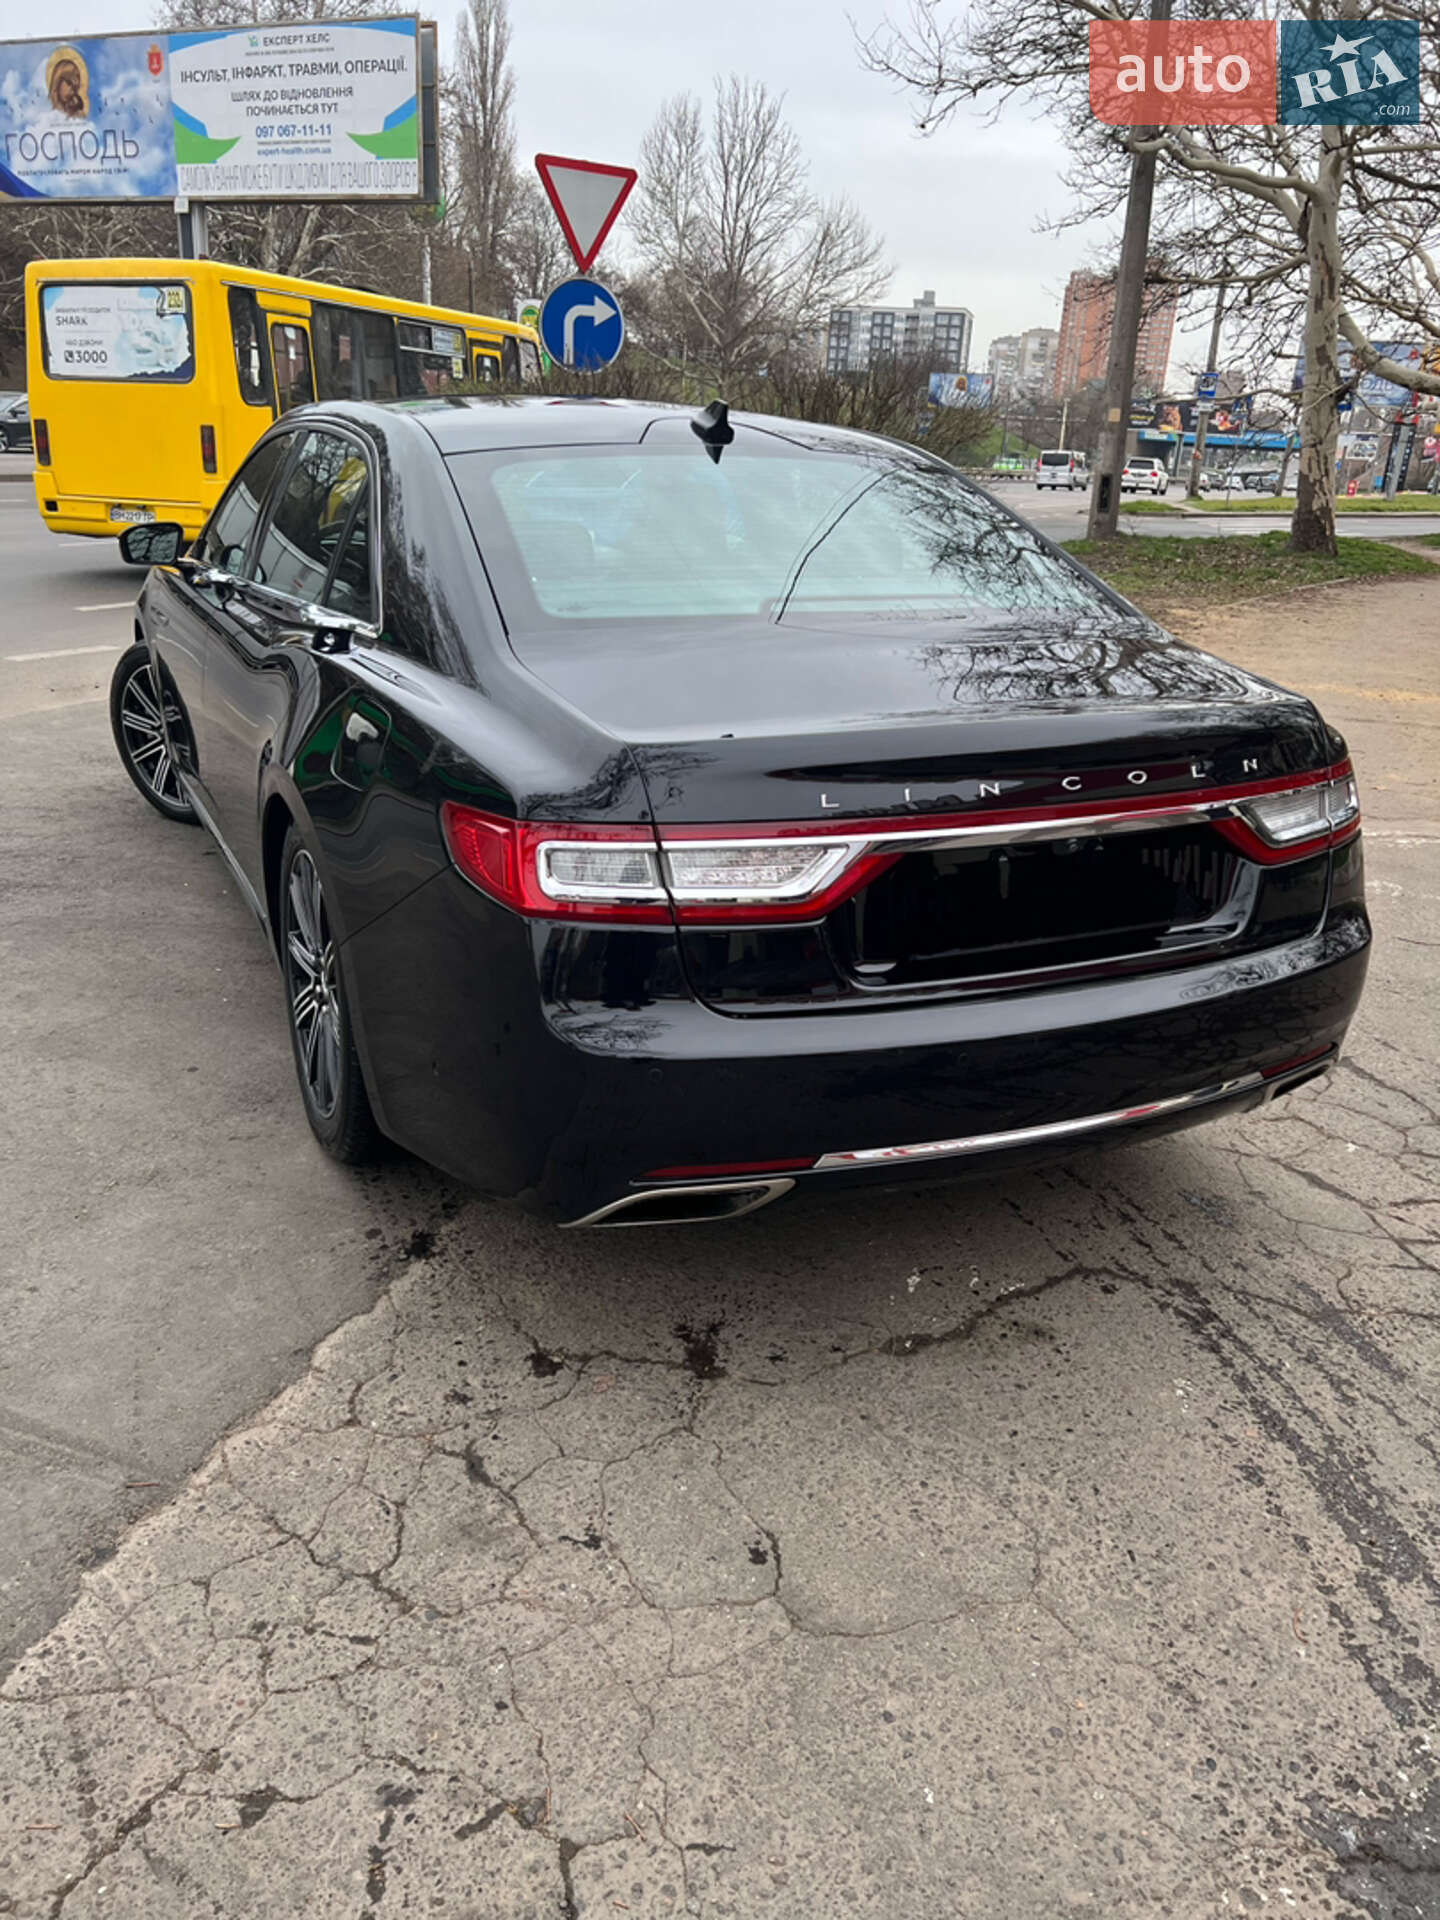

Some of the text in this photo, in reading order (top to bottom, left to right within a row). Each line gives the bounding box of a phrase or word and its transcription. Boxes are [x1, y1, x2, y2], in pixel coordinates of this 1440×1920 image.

[262, 32, 331, 47] ЕКСПЕРТ ХЕЛС
[180, 68, 231, 83] ІНСУЛЬТ,
[232, 64, 287, 80] ІНФАРКТ,
[288, 61, 342, 77] ТРАВМИ,
[231, 86, 354, 102] ШЛЯХ ДО ВІДНОВЛЕННЯ
[246, 102, 339, 117] ПОЧИНАЄТЬСЯ ТУТ
[255, 123, 332, 138] 097 067-11-11
[4, 129, 140, 165] ГОСПОДЬ
[56, 315, 88, 327] SHARK
[74, 350, 108, 363] 3000
[820, 757, 1260, 809] LINCOLN
